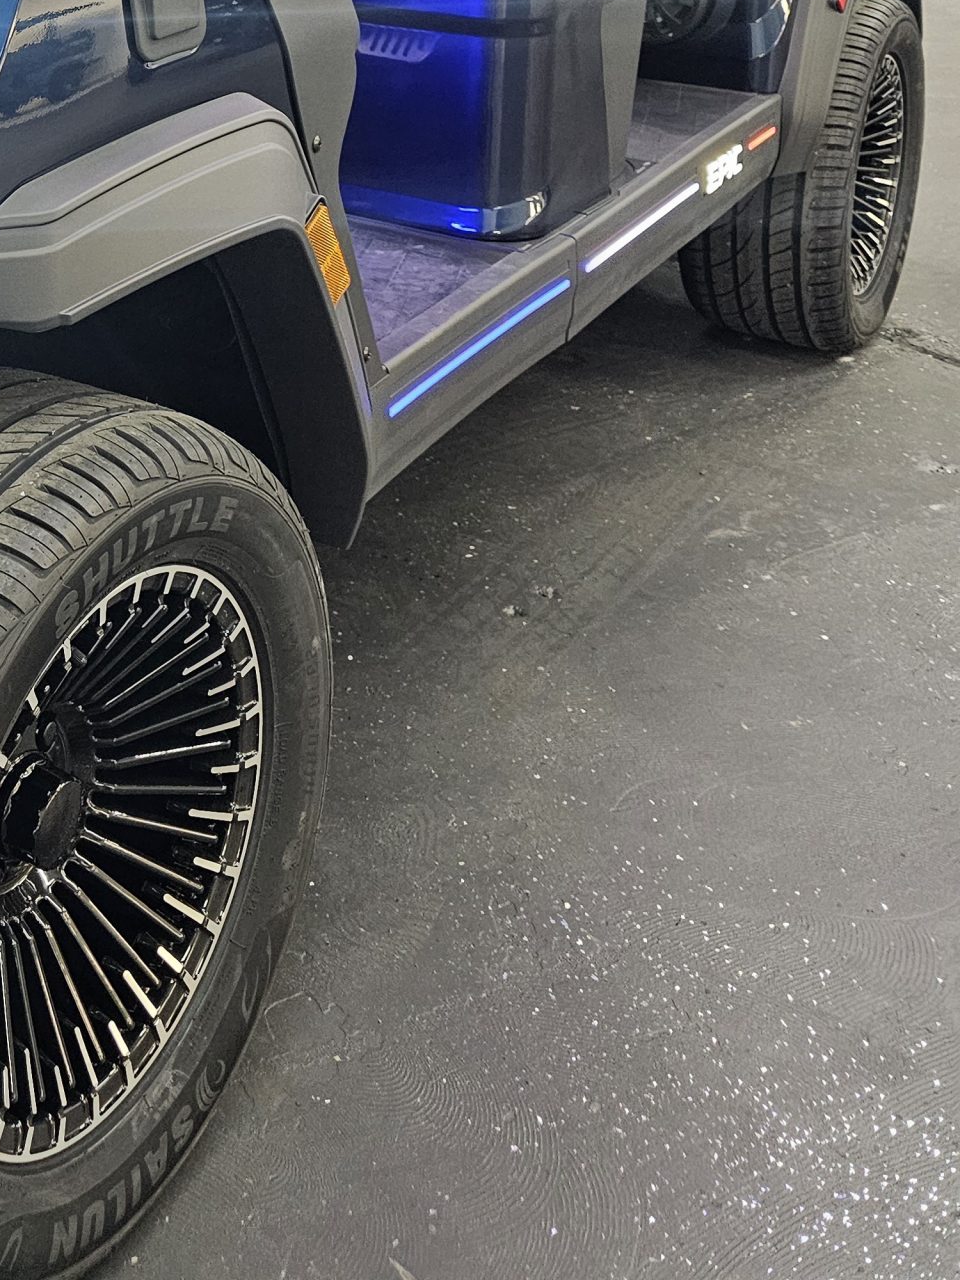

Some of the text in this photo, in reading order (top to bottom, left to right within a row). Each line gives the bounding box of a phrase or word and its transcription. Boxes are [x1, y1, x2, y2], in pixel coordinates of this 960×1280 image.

[706, 144, 743, 194] EPIC
[54, 496, 239, 639] SHUTTLE
[48, 1105, 194, 1265] SAILUN
